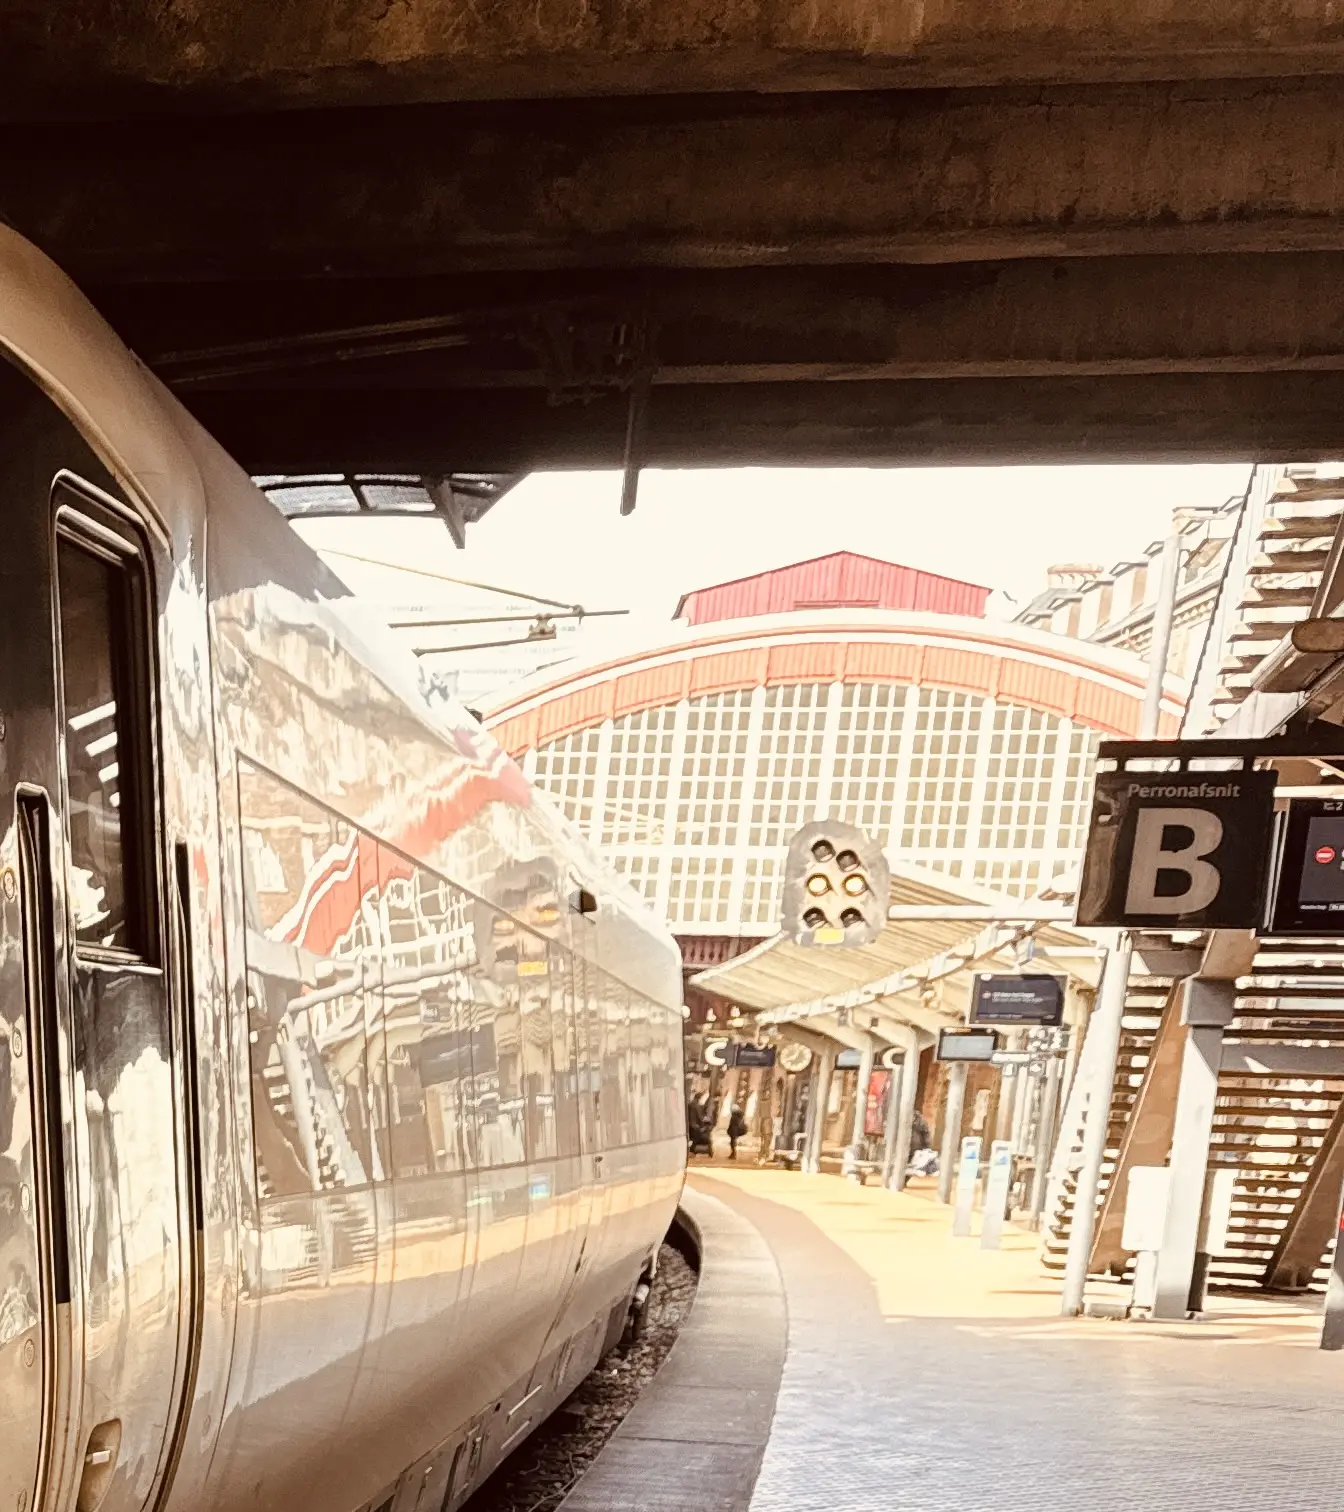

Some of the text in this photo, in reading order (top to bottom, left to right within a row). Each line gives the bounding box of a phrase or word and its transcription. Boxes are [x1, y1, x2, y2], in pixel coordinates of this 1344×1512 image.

[1127, 783, 1241, 798] Perronafsnit
[1124, 807, 1223, 915] B
[704, 1041, 727, 1066] C
